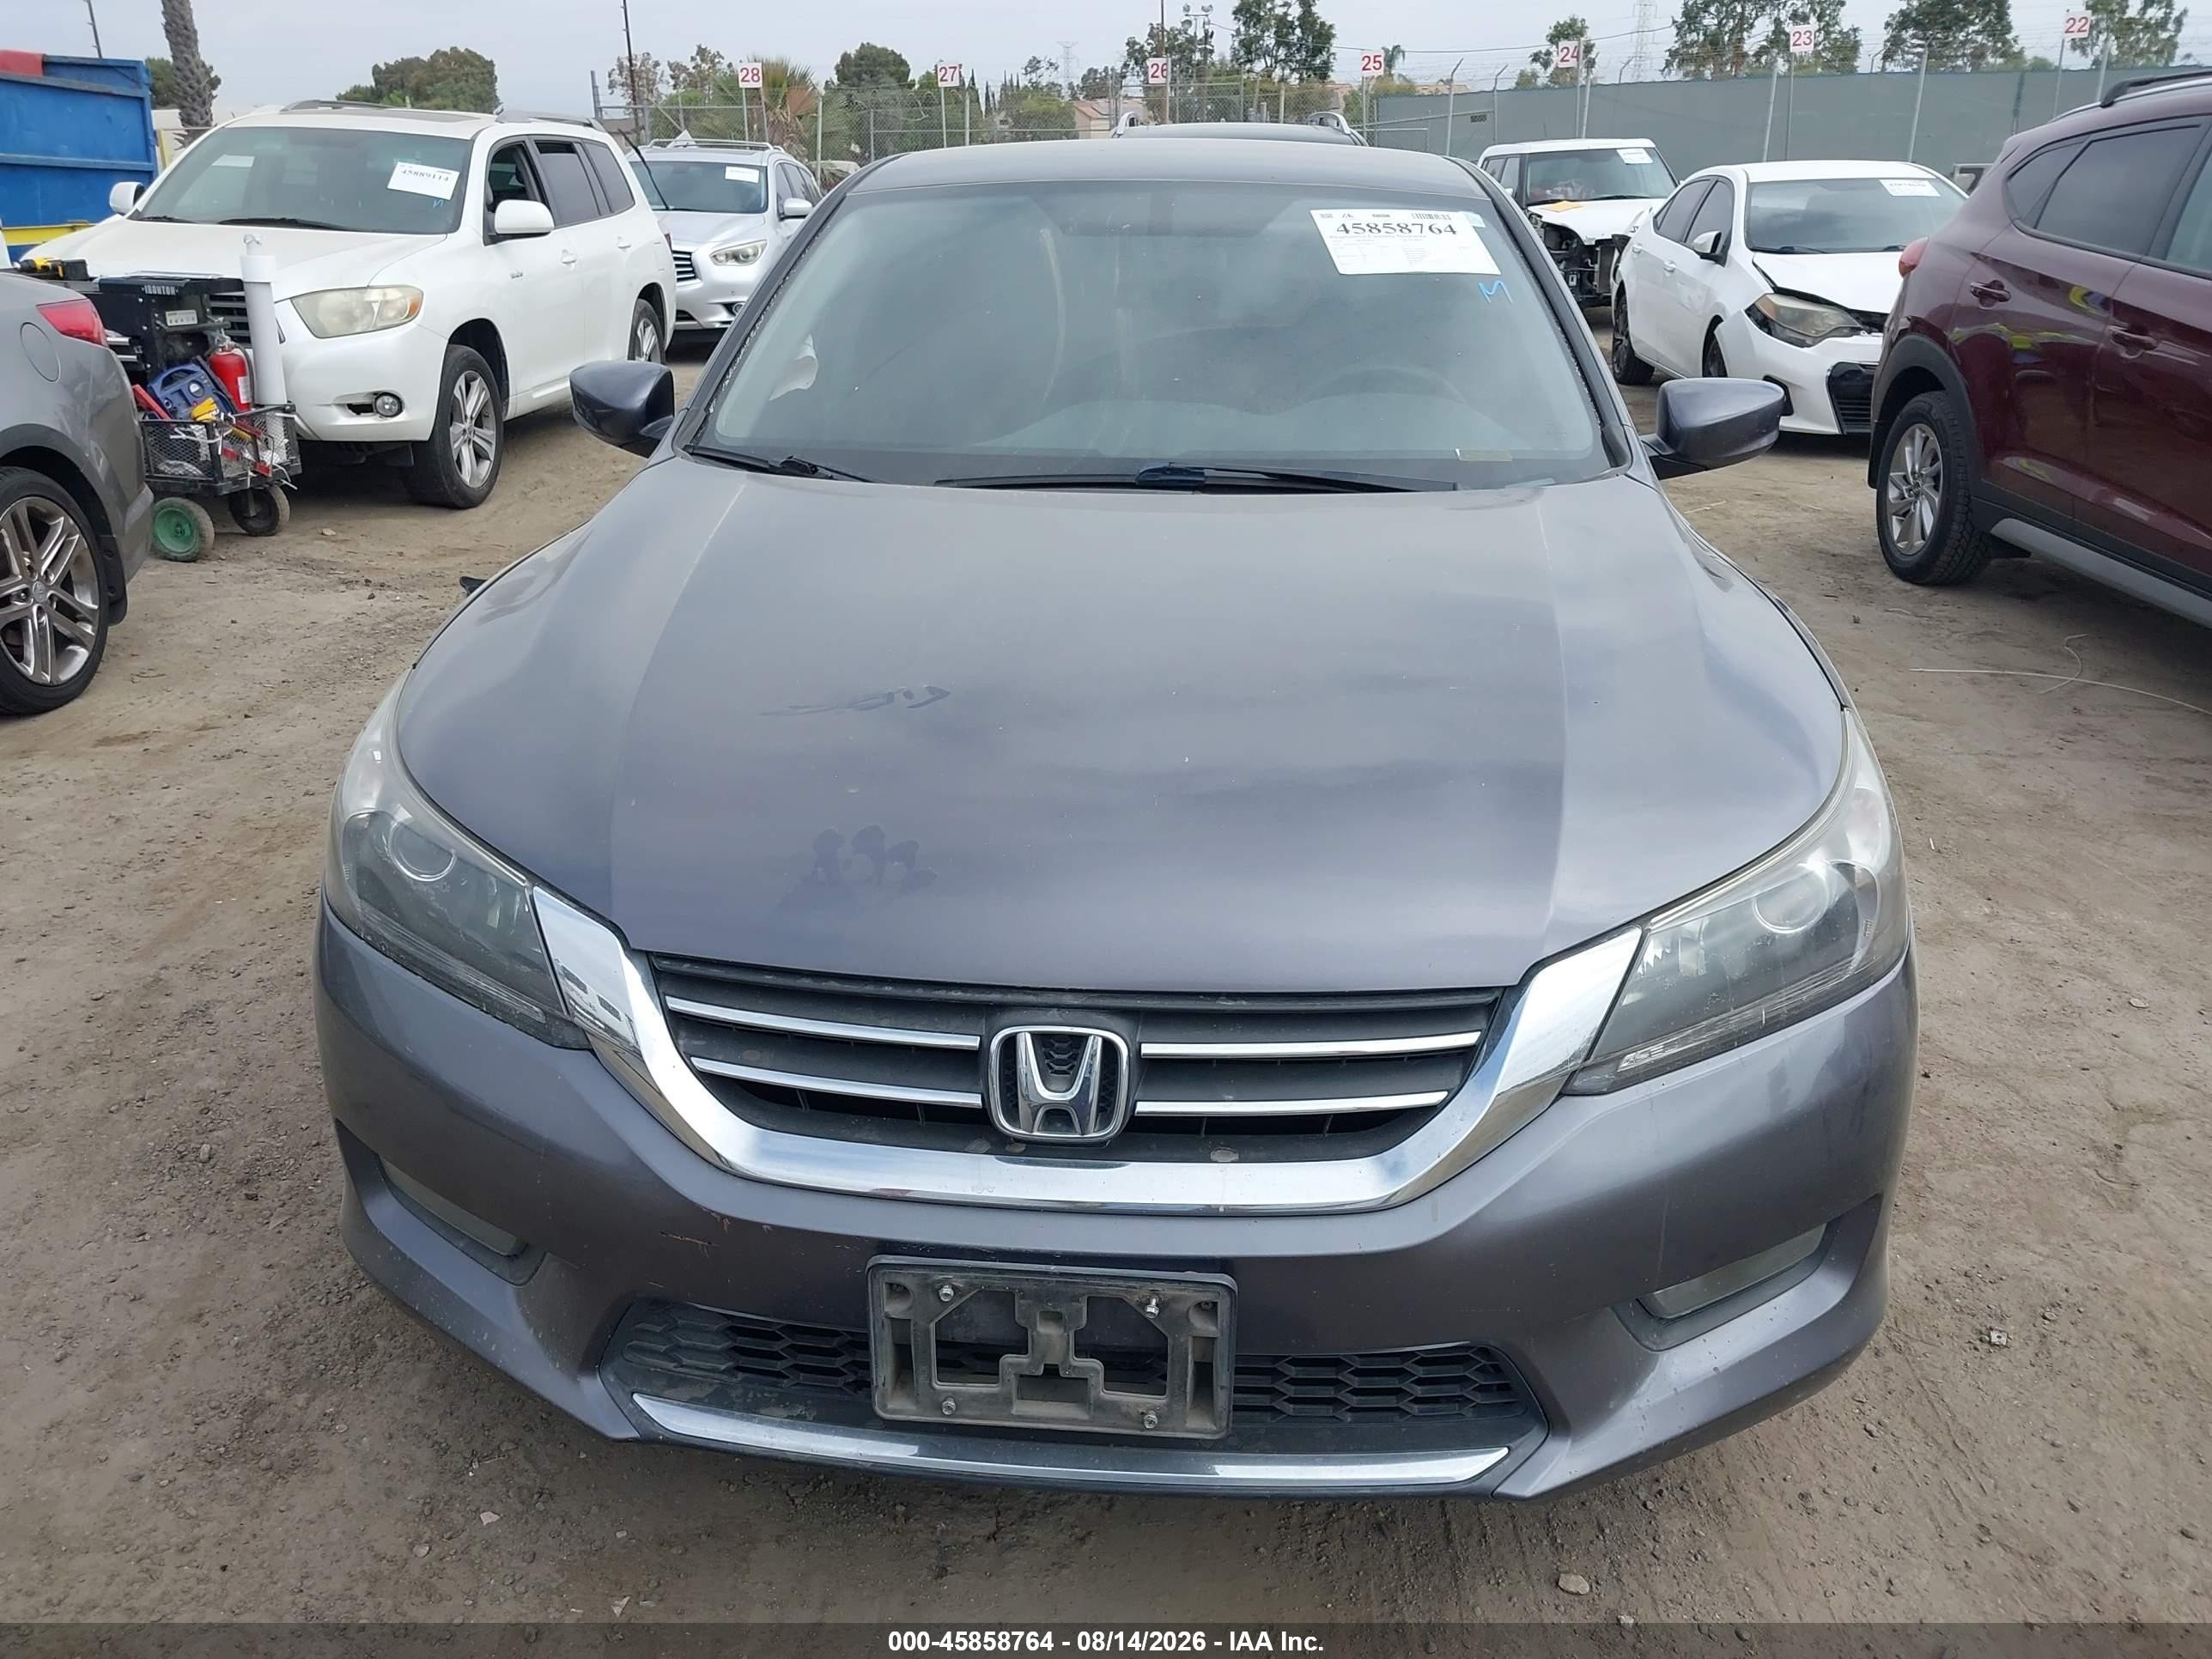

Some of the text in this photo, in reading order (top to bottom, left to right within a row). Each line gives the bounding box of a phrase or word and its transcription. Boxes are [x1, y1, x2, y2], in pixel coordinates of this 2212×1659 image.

[2064, 16, 2088, 33] 22
[1792, 30, 1813, 46] 23
[1362, 55, 1382, 70] 25
[1560, 46, 1580, 63] 24
[740, 67, 761, 82] 28
[939, 66, 957, 82] 27
[1151, 63, 1168, 79] 26
[1336, 222, 1457, 235] 45858764
